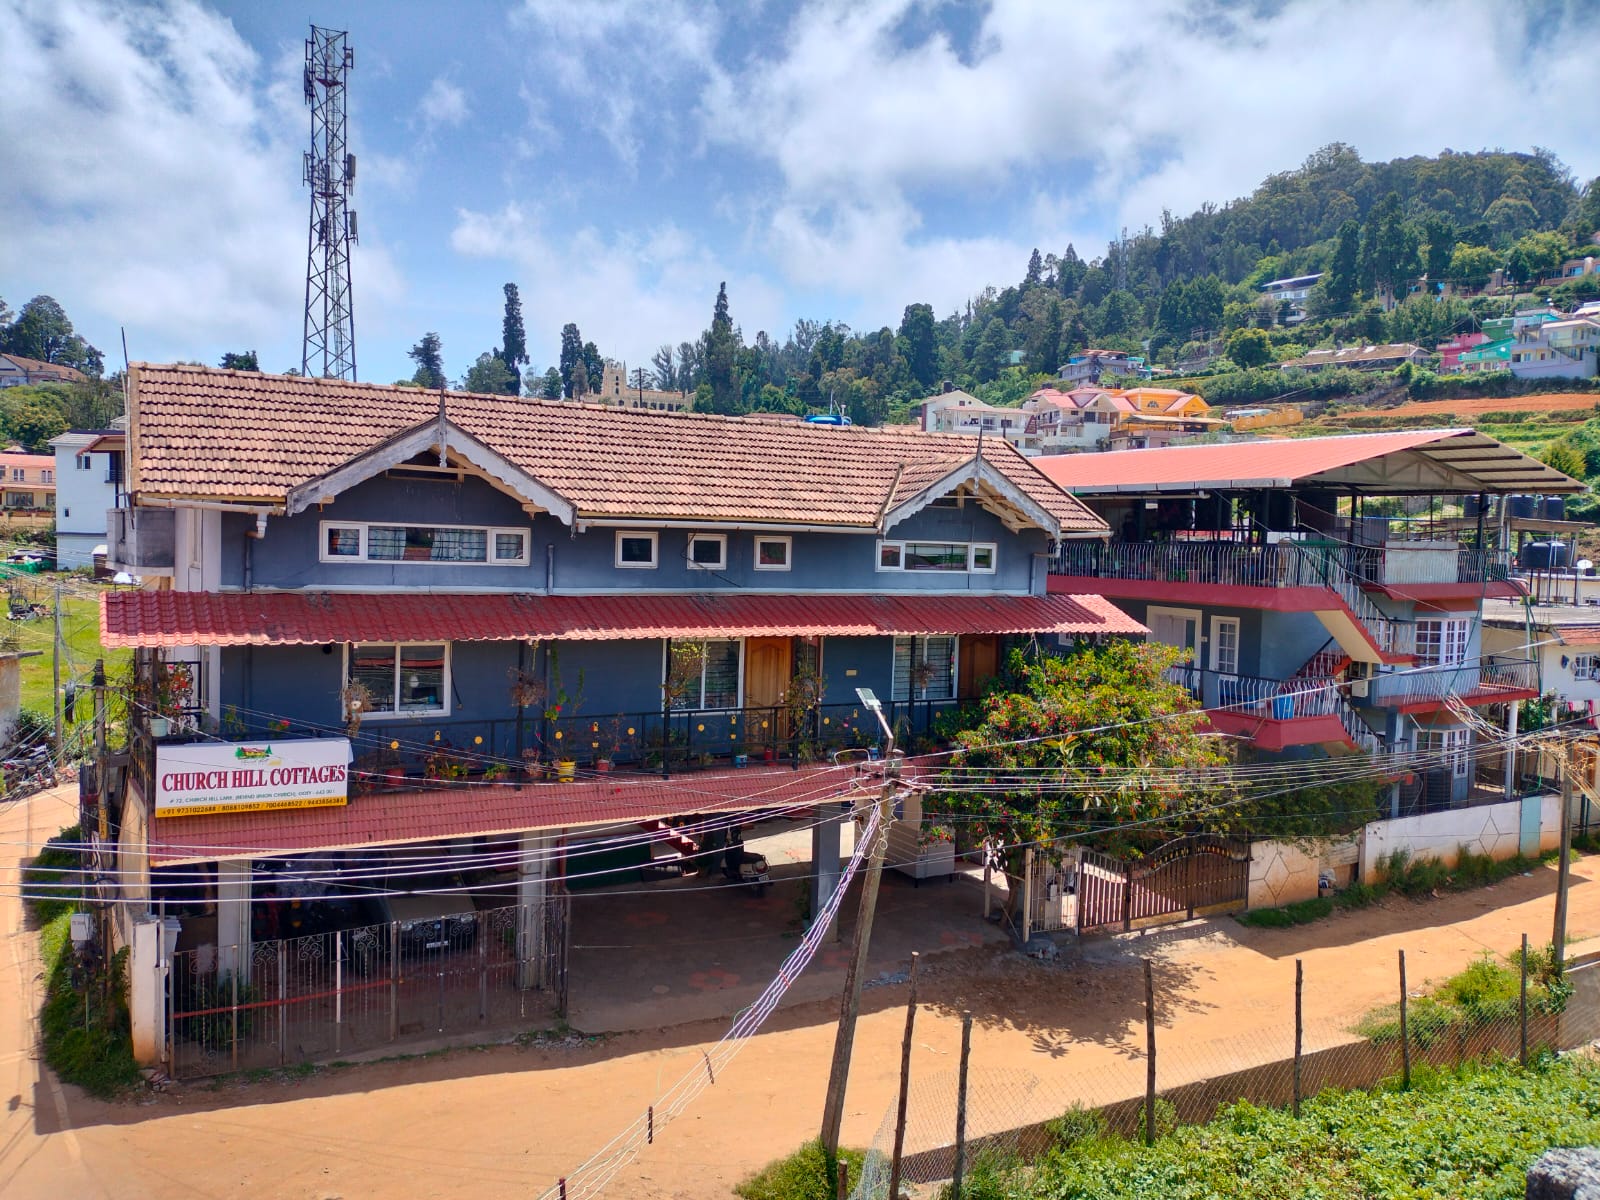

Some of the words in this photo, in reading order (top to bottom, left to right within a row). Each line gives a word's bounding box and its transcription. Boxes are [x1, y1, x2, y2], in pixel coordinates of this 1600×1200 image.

[162, 771, 228, 792] CHURCH
[231, 769, 268, 787] HILL
[270, 765, 346, 786] COTTAGES
